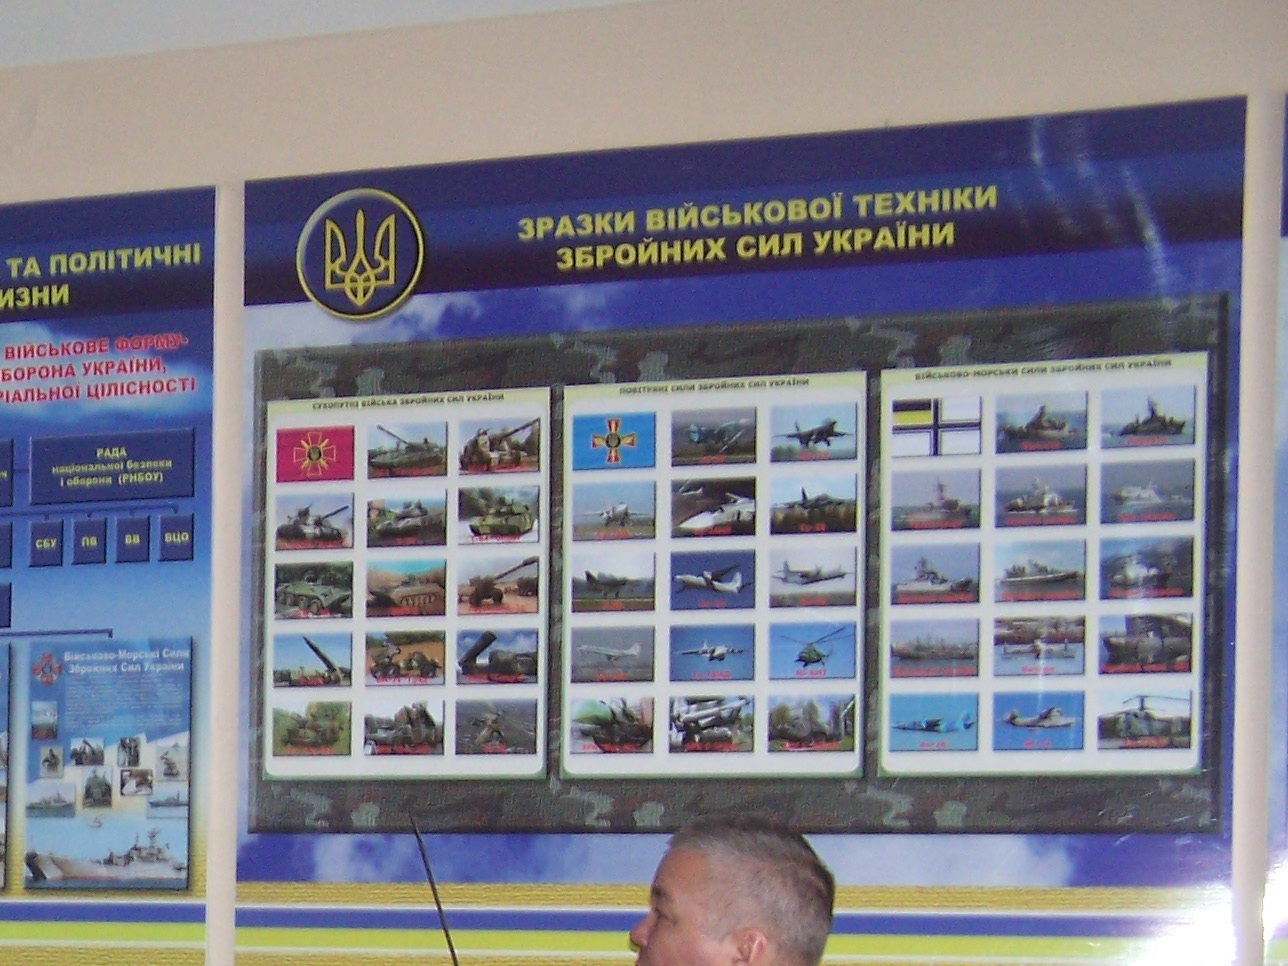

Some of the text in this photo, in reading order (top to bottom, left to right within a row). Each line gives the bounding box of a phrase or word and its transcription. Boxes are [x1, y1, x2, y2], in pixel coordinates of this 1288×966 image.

[518, 186, 998, 240] ЗРАЗКИ ВІЙСЬКОВОЇ ТЕХНІКИ
[557, 221, 955, 270] ЗБРОЙНИХ СИЛ УКРАЇНИ
[6, 257, 41, 279] ТА
[50, 243, 201, 275] ПОЛІТИЧНІ
[4, 337, 109, 361] ВІЙСЬКОВЕ
[82, 357, 167, 380] УКРАЇНИ,
[86, 376, 197, 401] ЦІЛІСНОСТІ
[96, 447, 128, 459] РАДА
[36, 539, 58, 549] СБУ
